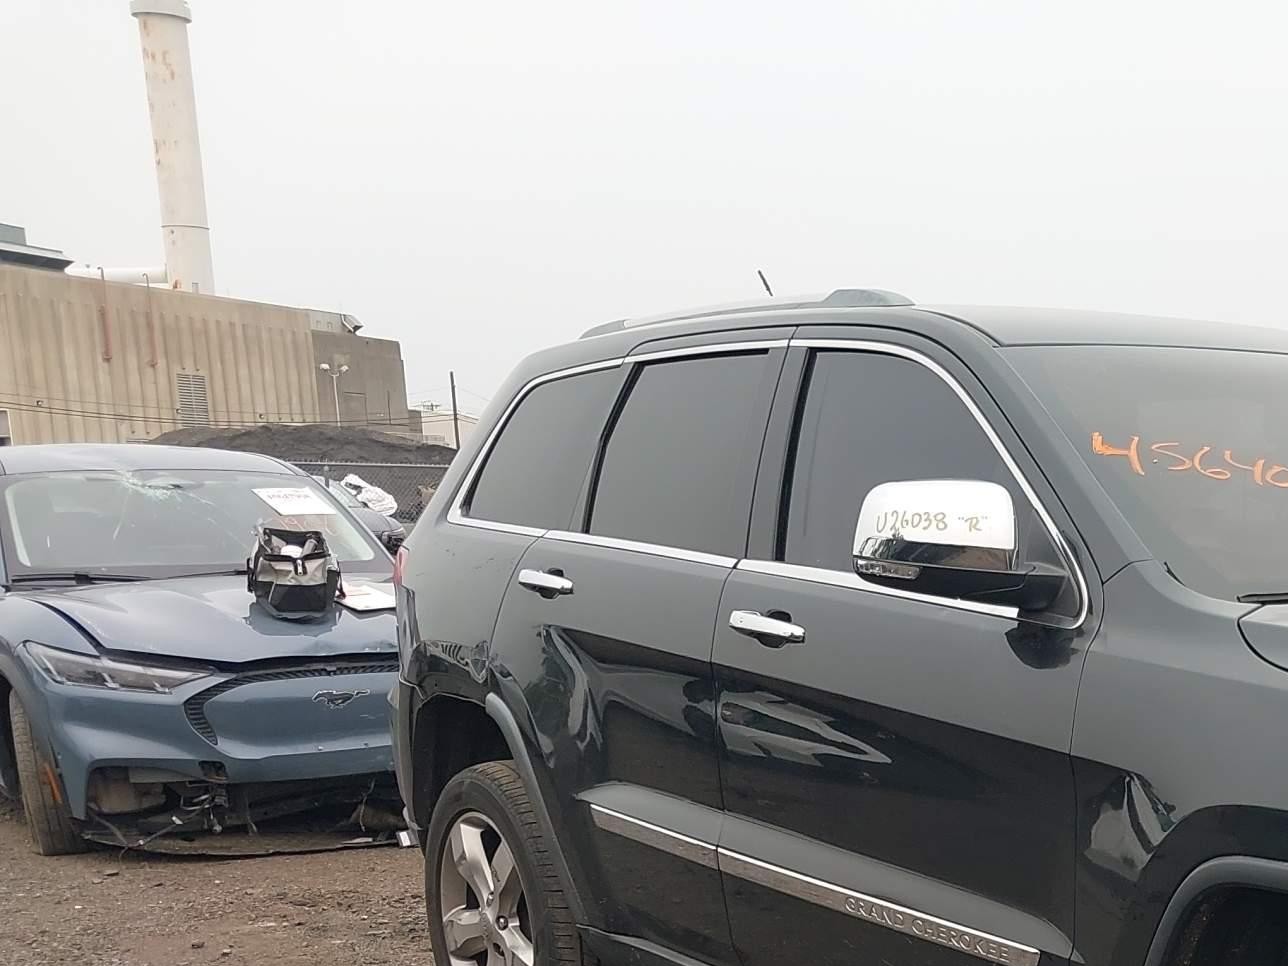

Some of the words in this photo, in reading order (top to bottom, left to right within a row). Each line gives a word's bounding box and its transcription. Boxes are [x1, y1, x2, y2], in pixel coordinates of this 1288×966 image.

[876, 510, 948, 534] U26038
[844, 896, 905, 928] GRAND
[910, 918, 1010, 963] CHEROKEE
